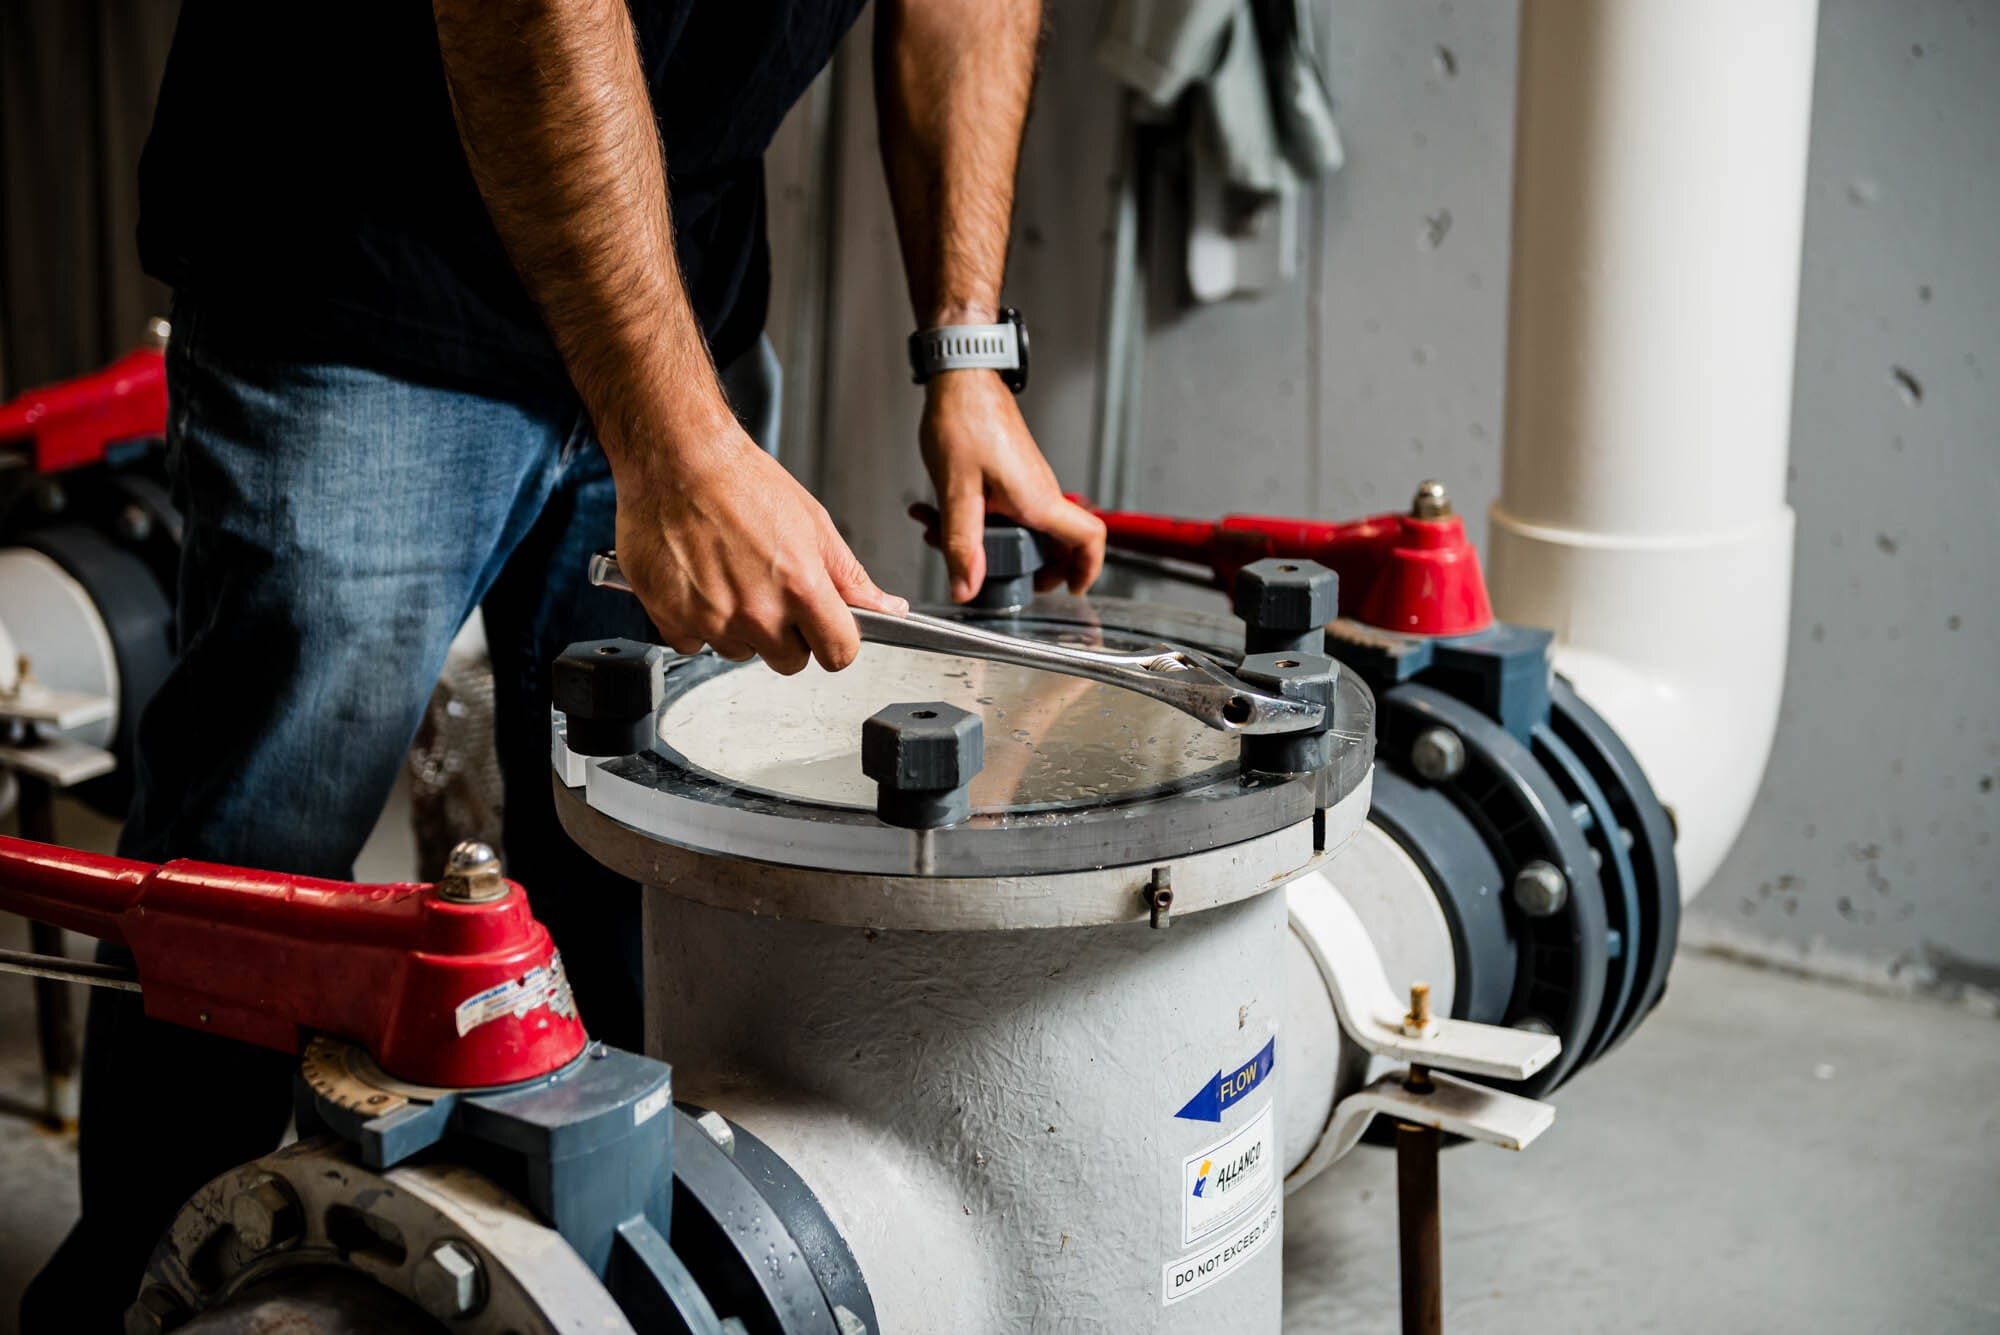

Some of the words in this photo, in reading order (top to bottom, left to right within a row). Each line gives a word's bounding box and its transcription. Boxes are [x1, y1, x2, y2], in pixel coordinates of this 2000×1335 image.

[1220, 1060, 1257, 1103] FLOW
[1216, 1141, 1261, 1192] ALLANCO
[1175, 1269, 1194, 1288] DO
[1198, 1253, 1222, 1278] NOT
[1223, 1226, 1261, 1263] EXCEED
